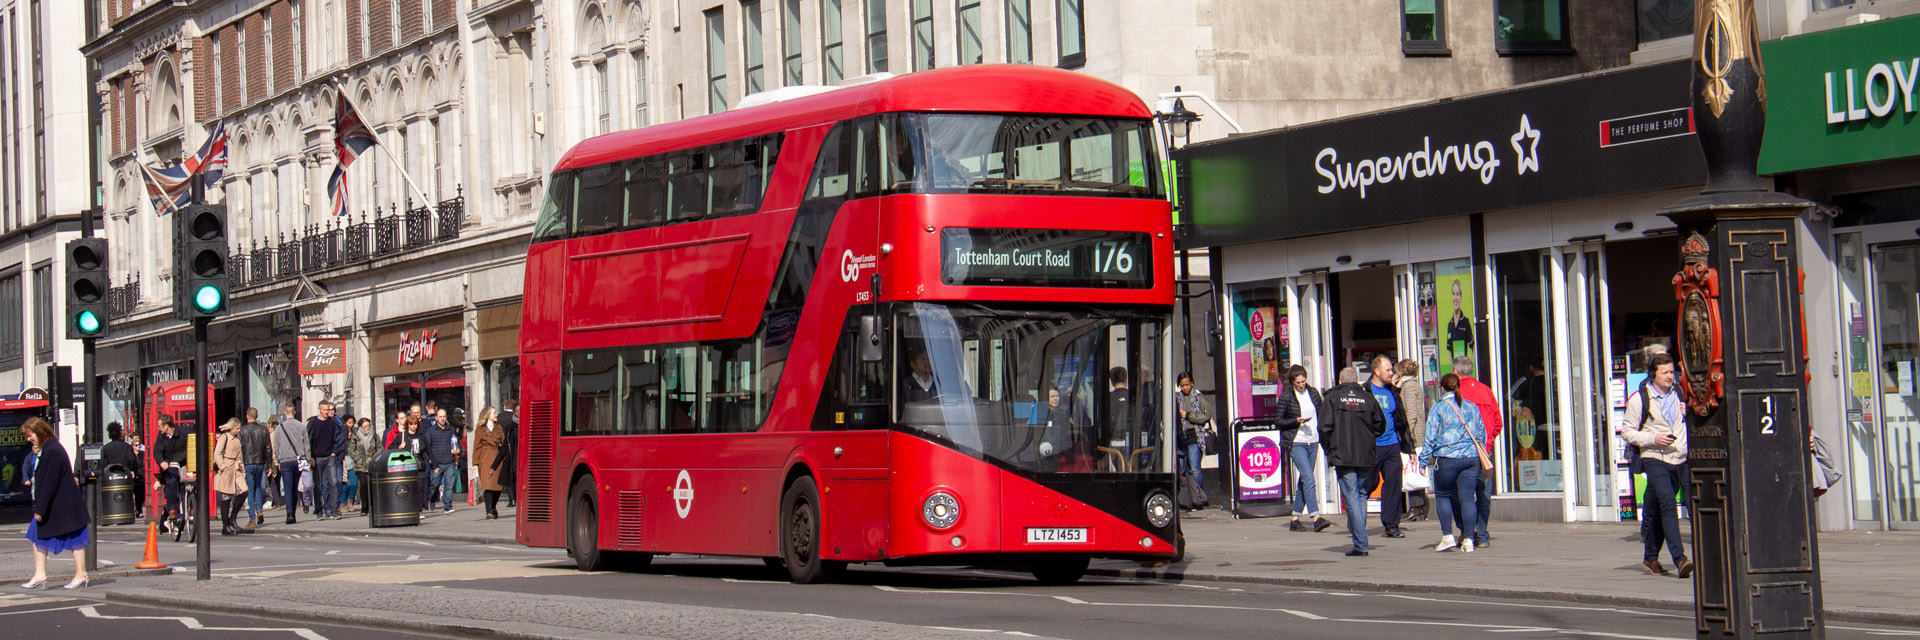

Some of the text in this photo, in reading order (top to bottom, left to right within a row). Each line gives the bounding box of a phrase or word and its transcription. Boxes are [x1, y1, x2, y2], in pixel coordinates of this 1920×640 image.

[1825, 57, 1920, 125] LLOY
[1611, 117, 1684, 137] THE PERFUME SHOP
[1314, 136, 1500, 199] Superdrug
[955, 240, 1133, 274] Tottenham Court Road 176
[305, 344, 341, 369] Pizza Hut
[398, 328, 438, 366] Pizza Hut
[1034, 529, 1080, 541] LTZ 1453
